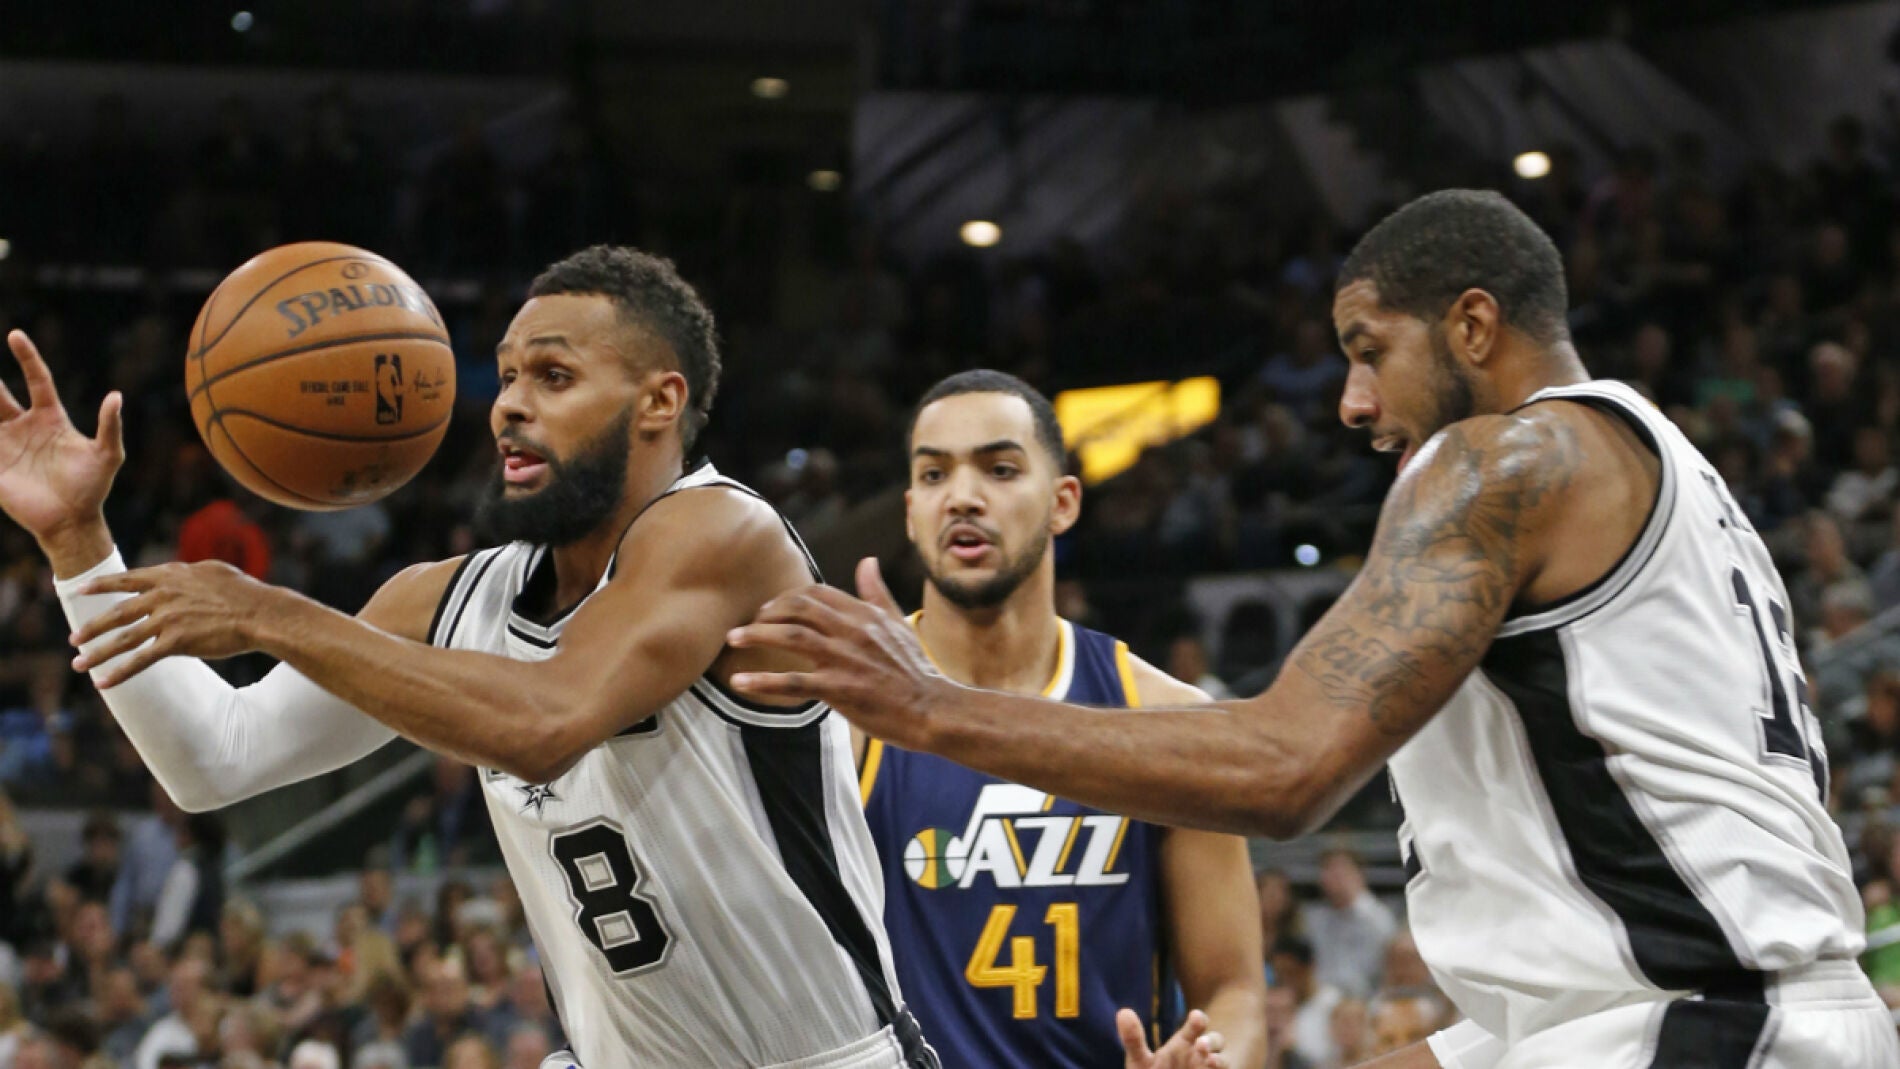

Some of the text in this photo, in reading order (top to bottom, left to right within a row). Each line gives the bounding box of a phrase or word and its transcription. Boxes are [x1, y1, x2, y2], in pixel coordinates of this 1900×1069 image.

[276, 283, 444, 338] SPALDI
[904, 783, 1130, 890] JAZZ
[548, 815, 677, 979] 8
[964, 902, 1081, 1020] 41
